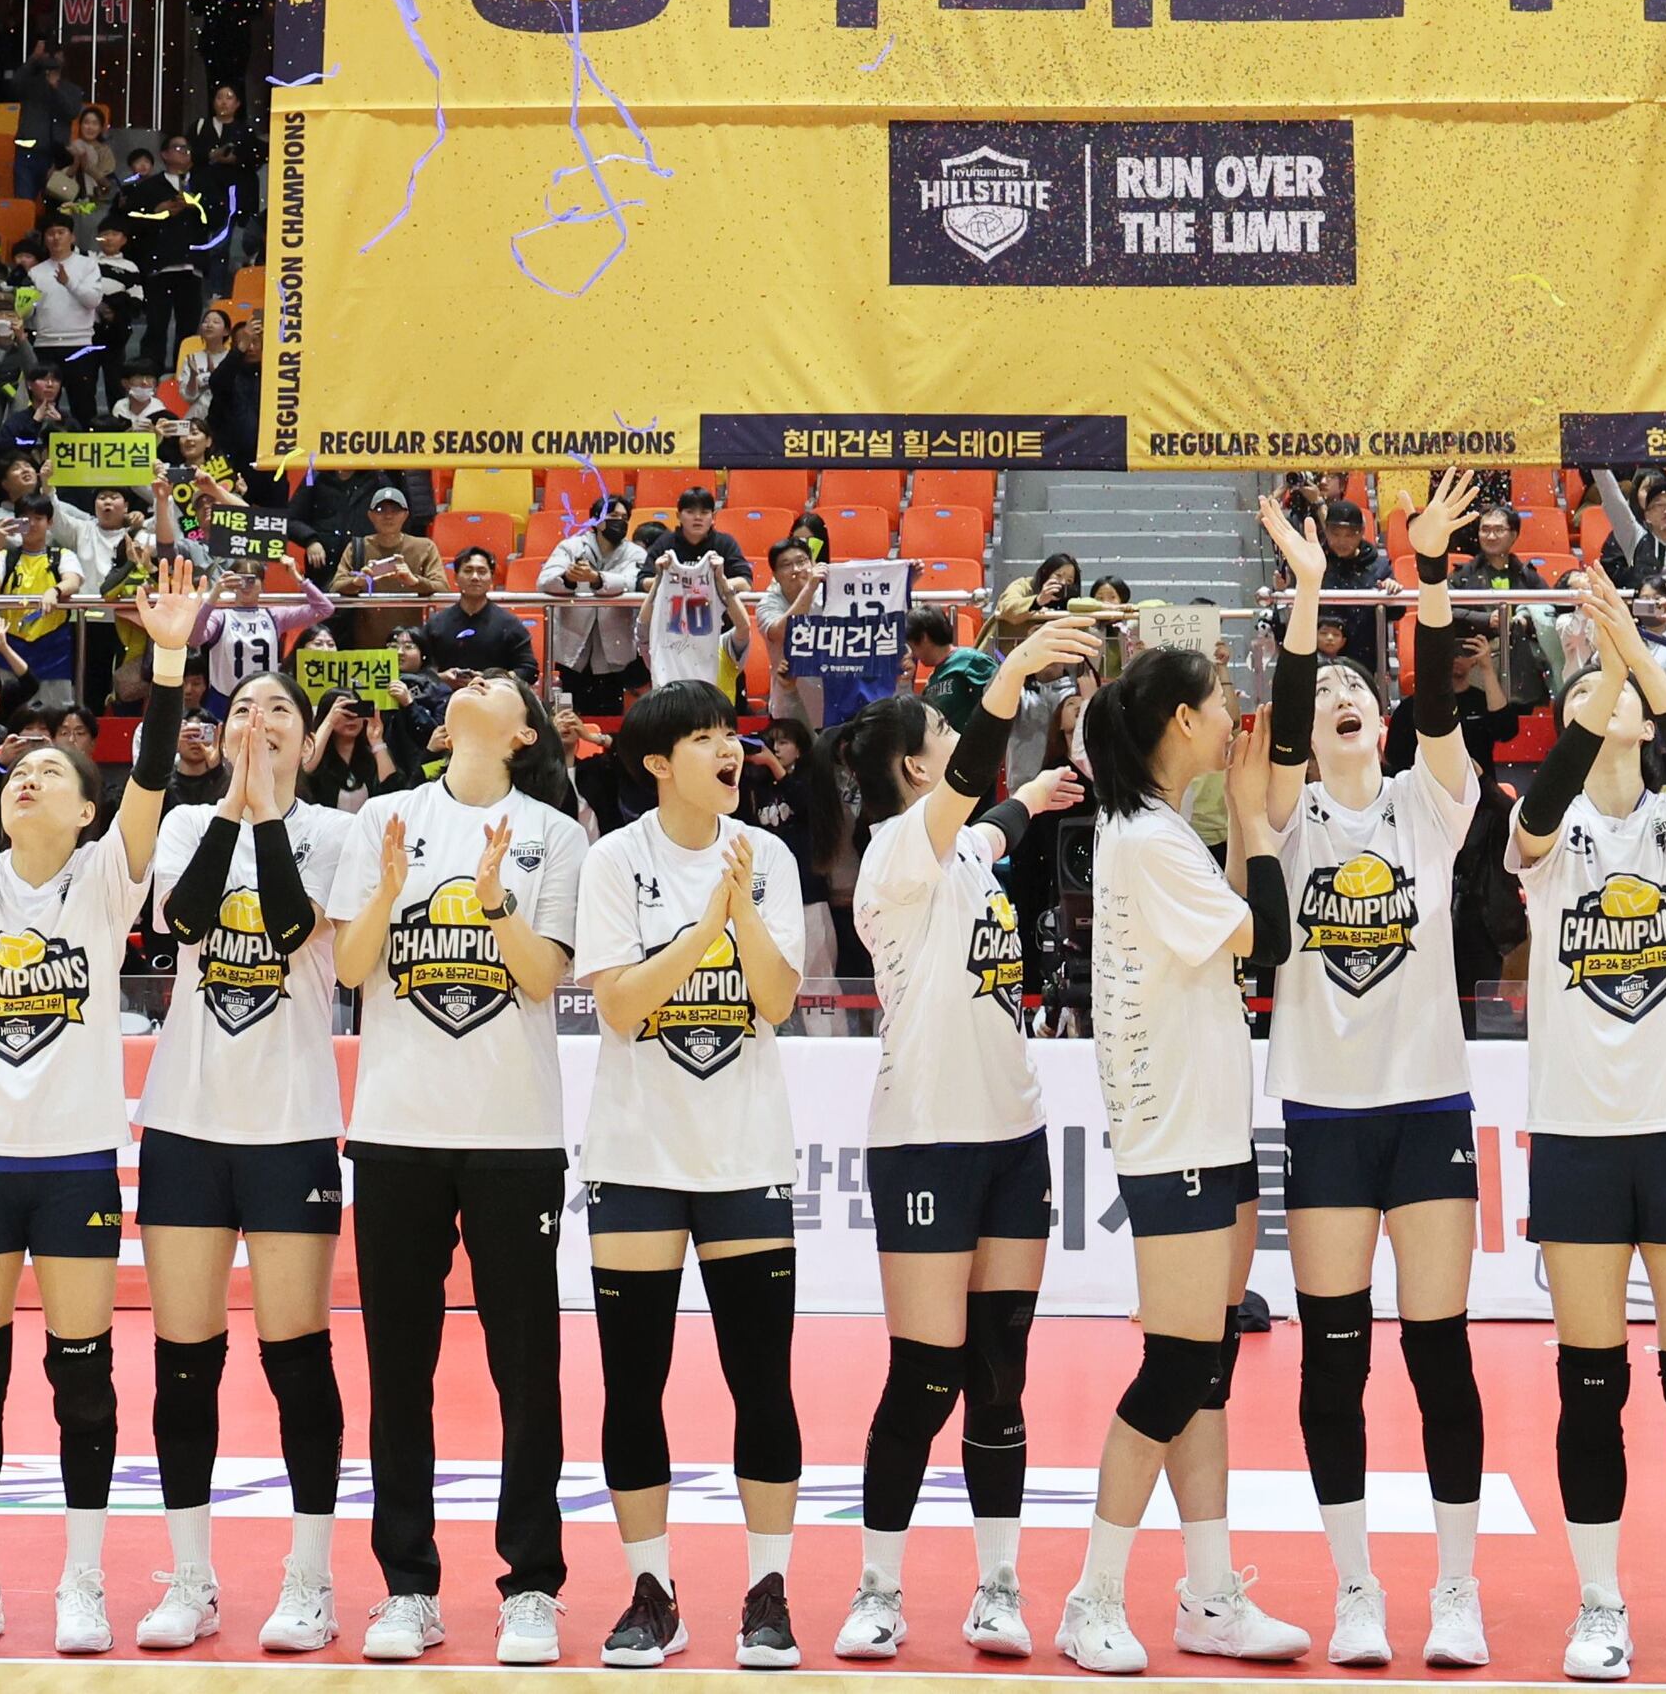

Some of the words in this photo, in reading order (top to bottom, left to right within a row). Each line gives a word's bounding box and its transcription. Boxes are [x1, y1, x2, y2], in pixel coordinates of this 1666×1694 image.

[281, 111, 306, 250] CHAMPIONS
[1116, 156, 1204, 199] RUN
[1214, 155, 1326, 200] OVER
[919, 180, 1052, 210] HILLSTATE
[1118, 211, 1197, 253] THE
[1212, 210, 1326, 254] LIMIT
[279, 256, 303, 344] SEASON
[274, 350, 302, 455] REGULAR
[318, 429, 426, 455] REGULAR
[432, 429, 524, 454] SEASON
[532, 429, 676, 455] CHAMPIONS
[783, 428, 895, 458] 현대건설
[903, 428, 1044, 458] 힐스테이트
[1149, 431, 1261, 456] REGULAR
[1267, 431, 1361, 456] SEASON
[1367, 430, 1516, 455] CHAMPIONS
[252, 514, 287, 534] 보러
[1149, 612, 1201, 637] 우승은
[790, 620, 899, 658] 현대건설
[232, 639, 271, 675] 13
[304, 659, 392, 691] 현대건설
[391, 930, 500, 964] CHAMPIO
[1319, 929, 1349, 943] 23-24
[414, 967, 444, 982] 23-24
[444, 967, 490, 983] 정규리그
[1588, 958, 1619, 972] 23-24
[45, 997, 61, 1012] 1위
[220, 993, 256, 1007] HILLSTATE
[439, 993, 477, 1006] HILLSTATE
[659, 1008, 687, 1023] 23-24
[687, 1008, 731, 1023] 정규리그
[731, 1008, 747, 1023] 1위
[684, 1035, 721, 1047] HILLSTATE
[906, 1191, 935, 1226] 10
